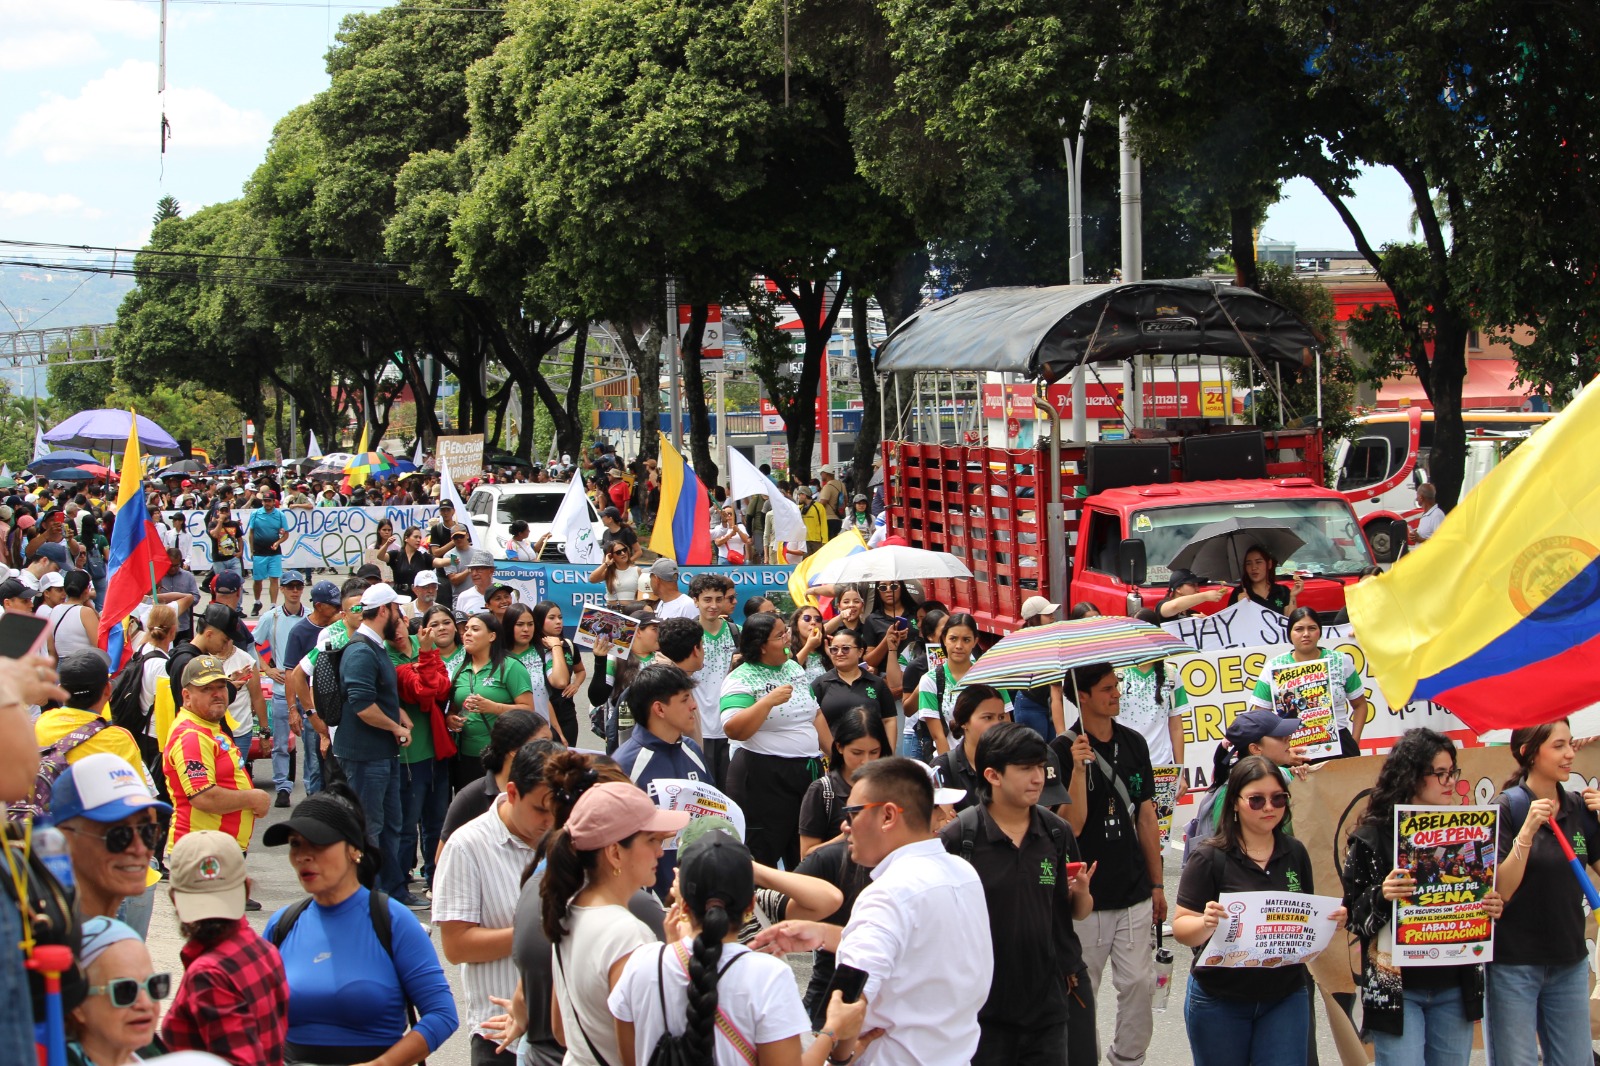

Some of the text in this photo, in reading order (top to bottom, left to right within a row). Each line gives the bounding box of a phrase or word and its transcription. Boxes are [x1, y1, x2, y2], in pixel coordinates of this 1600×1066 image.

[1057, 394, 1115, 408] Druería
[1206, 392, 1224, 405] 24
[237, 508, 366, 535] VDADERO
[517, 570, 544, 578] PILOTO
[1178, 609, 1238, 650] HAY
[1279, 663, 1322, 684] ABELARDO
[1286, 678, 1303, 689] QUE
[1301, 686, 1325, 698] SENA
[1046, 766, 1057, 779] R
[1405, 812, 1490, 833] ABELARDO
[1413, 826, 1488, 845] QUE PENA,
[1413, 881, 1480, 895] LA PLATA ES DEL
[1265, 899, 1314, 910] MATERIALES,
[1419, 890, 1476, 906] SENA
[1260, 907, 1311, 916] CONECTIVIDAD
[1404, 908, 1414, 916] SUS
[1415, 907, 1442, 915] RECURSOS
[1453, 902, 1484, 914] SAGRAD
[1266, 914, 1308, 923] BIENESTAR.
[1256, 925, 1316, 935] ¿SON LUJOS? NO,
[1405, 922, 1487, 944] PRIVATIZACIÓN!
[1421, 920, 1472, 933] ¡ABAJO LA
[1268, 933, 1304, 941] DERECHOS
[1305, 934, 1316, 942] DE
[1269, 940, 1312, 948] APRENDICES
[1278, 947, 1299, 955] SENA.
